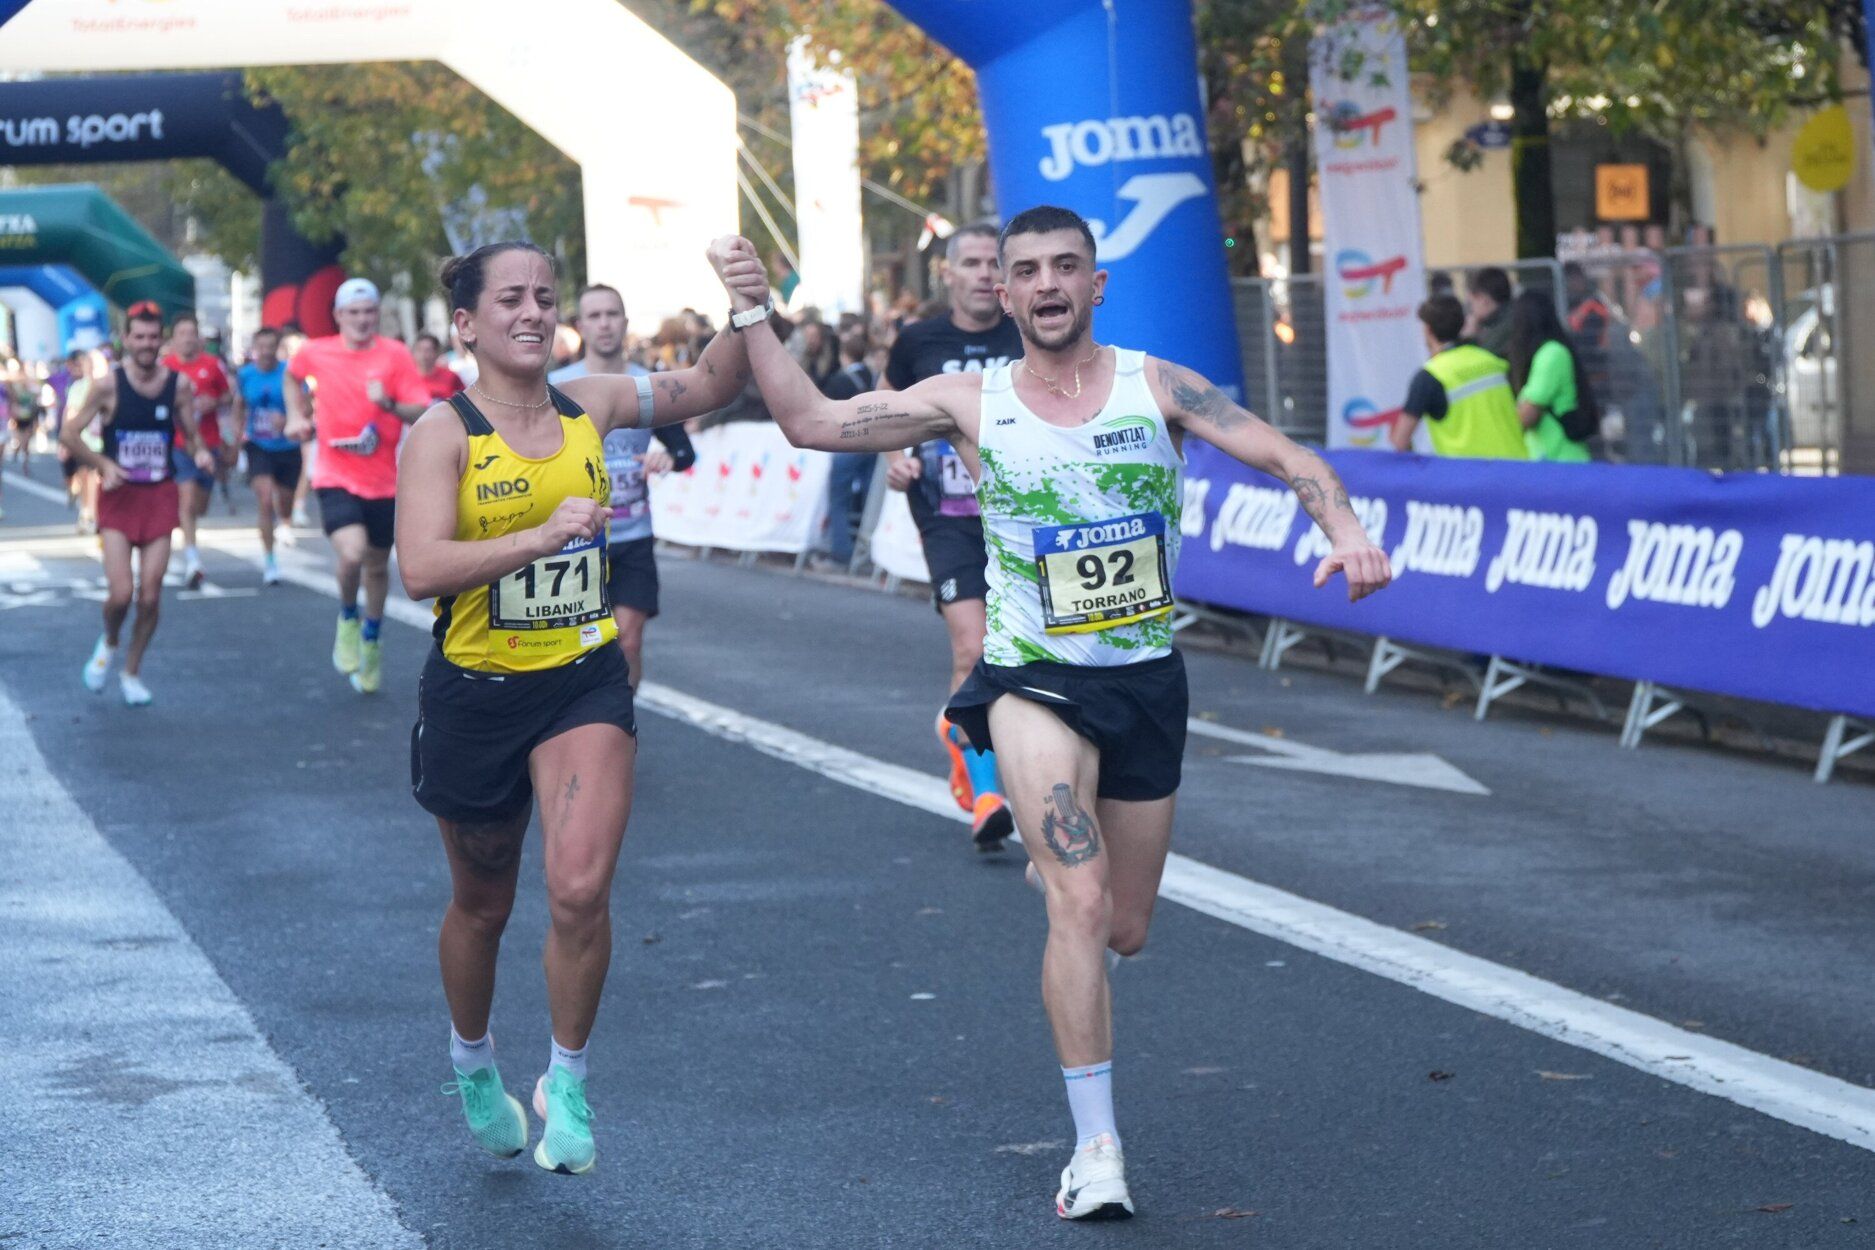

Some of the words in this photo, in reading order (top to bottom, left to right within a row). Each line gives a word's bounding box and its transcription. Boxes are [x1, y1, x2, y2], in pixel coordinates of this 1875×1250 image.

[66, 108, 164, 148] sport
[996, 418, 1016, 426] ZAIK
[1093, 427, 1146, 449] DENONTZAT
[1096, 442, 1147, 456] RUNNING
[477, 477, 530, 501] INDO
[515, 555, 589, 599] 171
[1076, 549, 1135, 591] 92
[525, 600, 585, 618] LIBANIX
[1071, 588, 1146, 612] TORRANO
